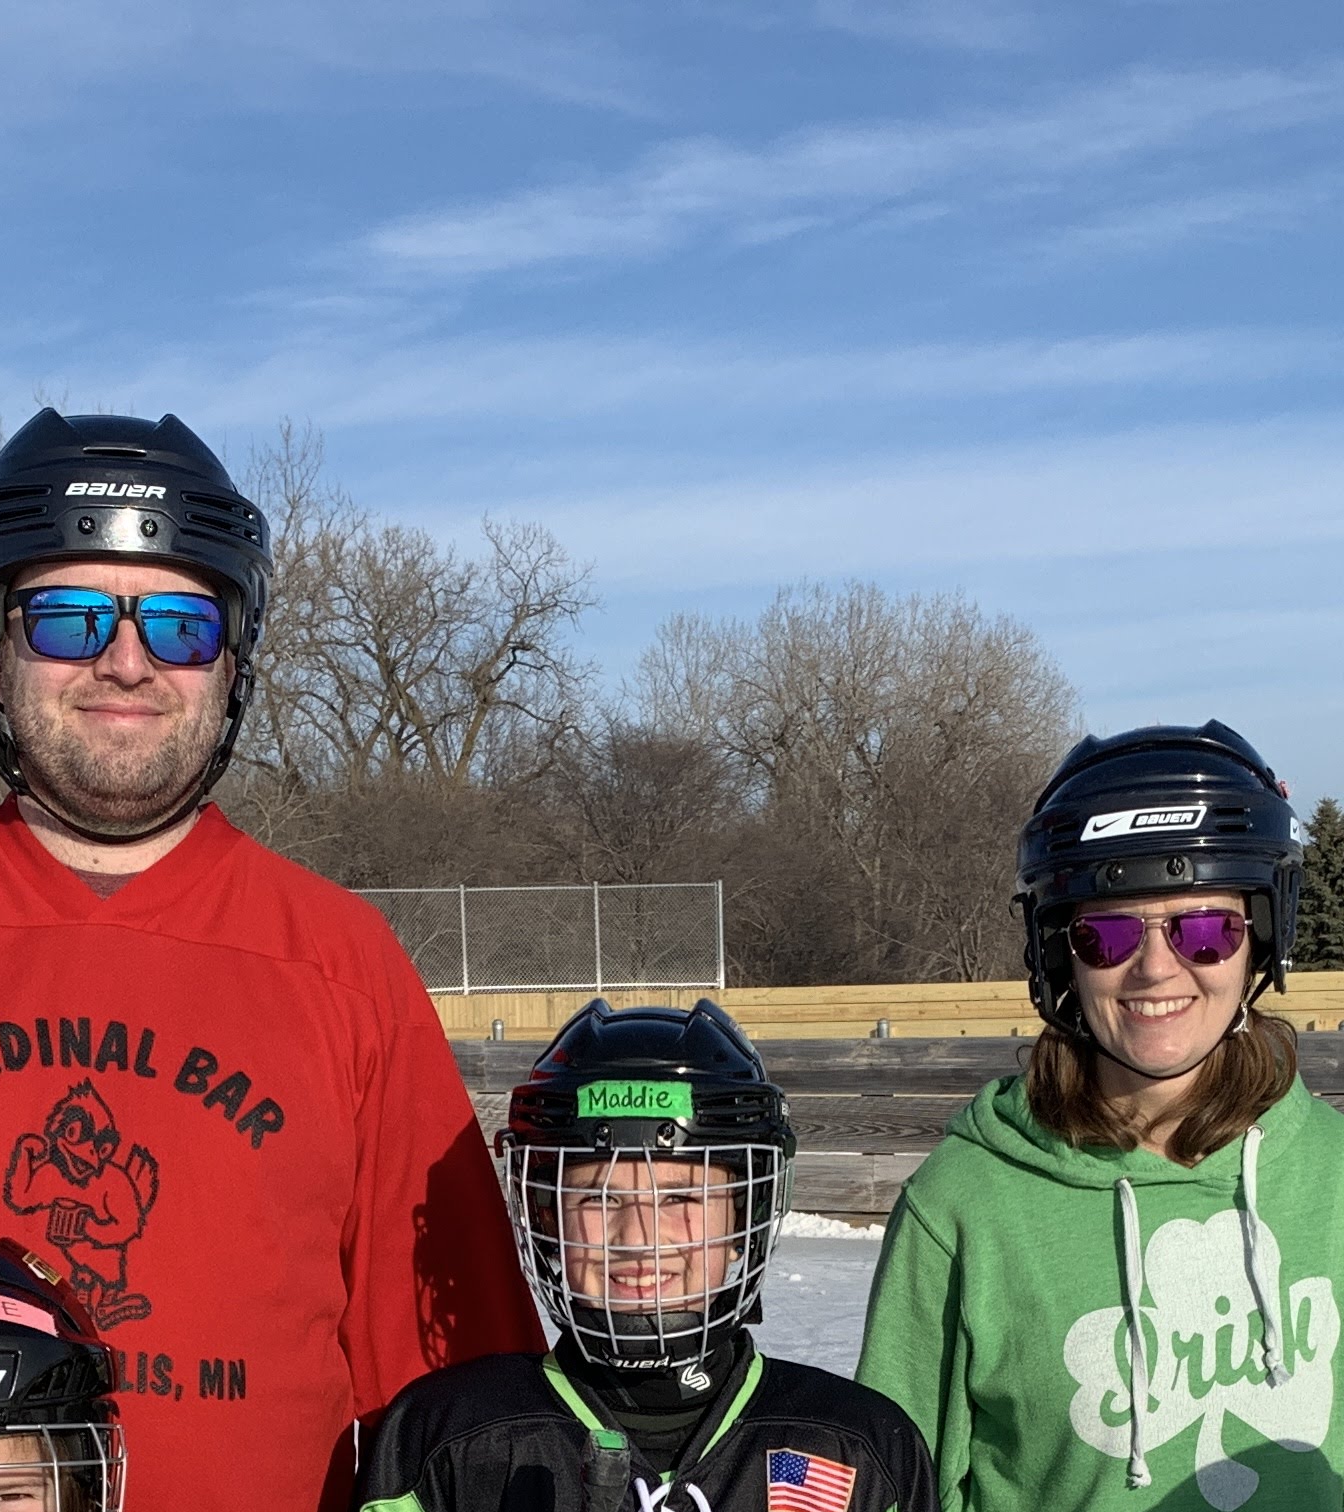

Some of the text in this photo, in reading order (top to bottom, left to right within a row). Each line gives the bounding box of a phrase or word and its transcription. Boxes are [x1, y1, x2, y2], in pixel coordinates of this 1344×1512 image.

[65, 481, 167, 500] BAUER
[1136, 811, 1194, 827] BAUER
[174, 1047, 287, 1149] BAR
[588, 1085, 673, 1110] Maddie
[1100, 1294, 1316, 1427] Irish
[199, 1357, 247, 1400] MN
